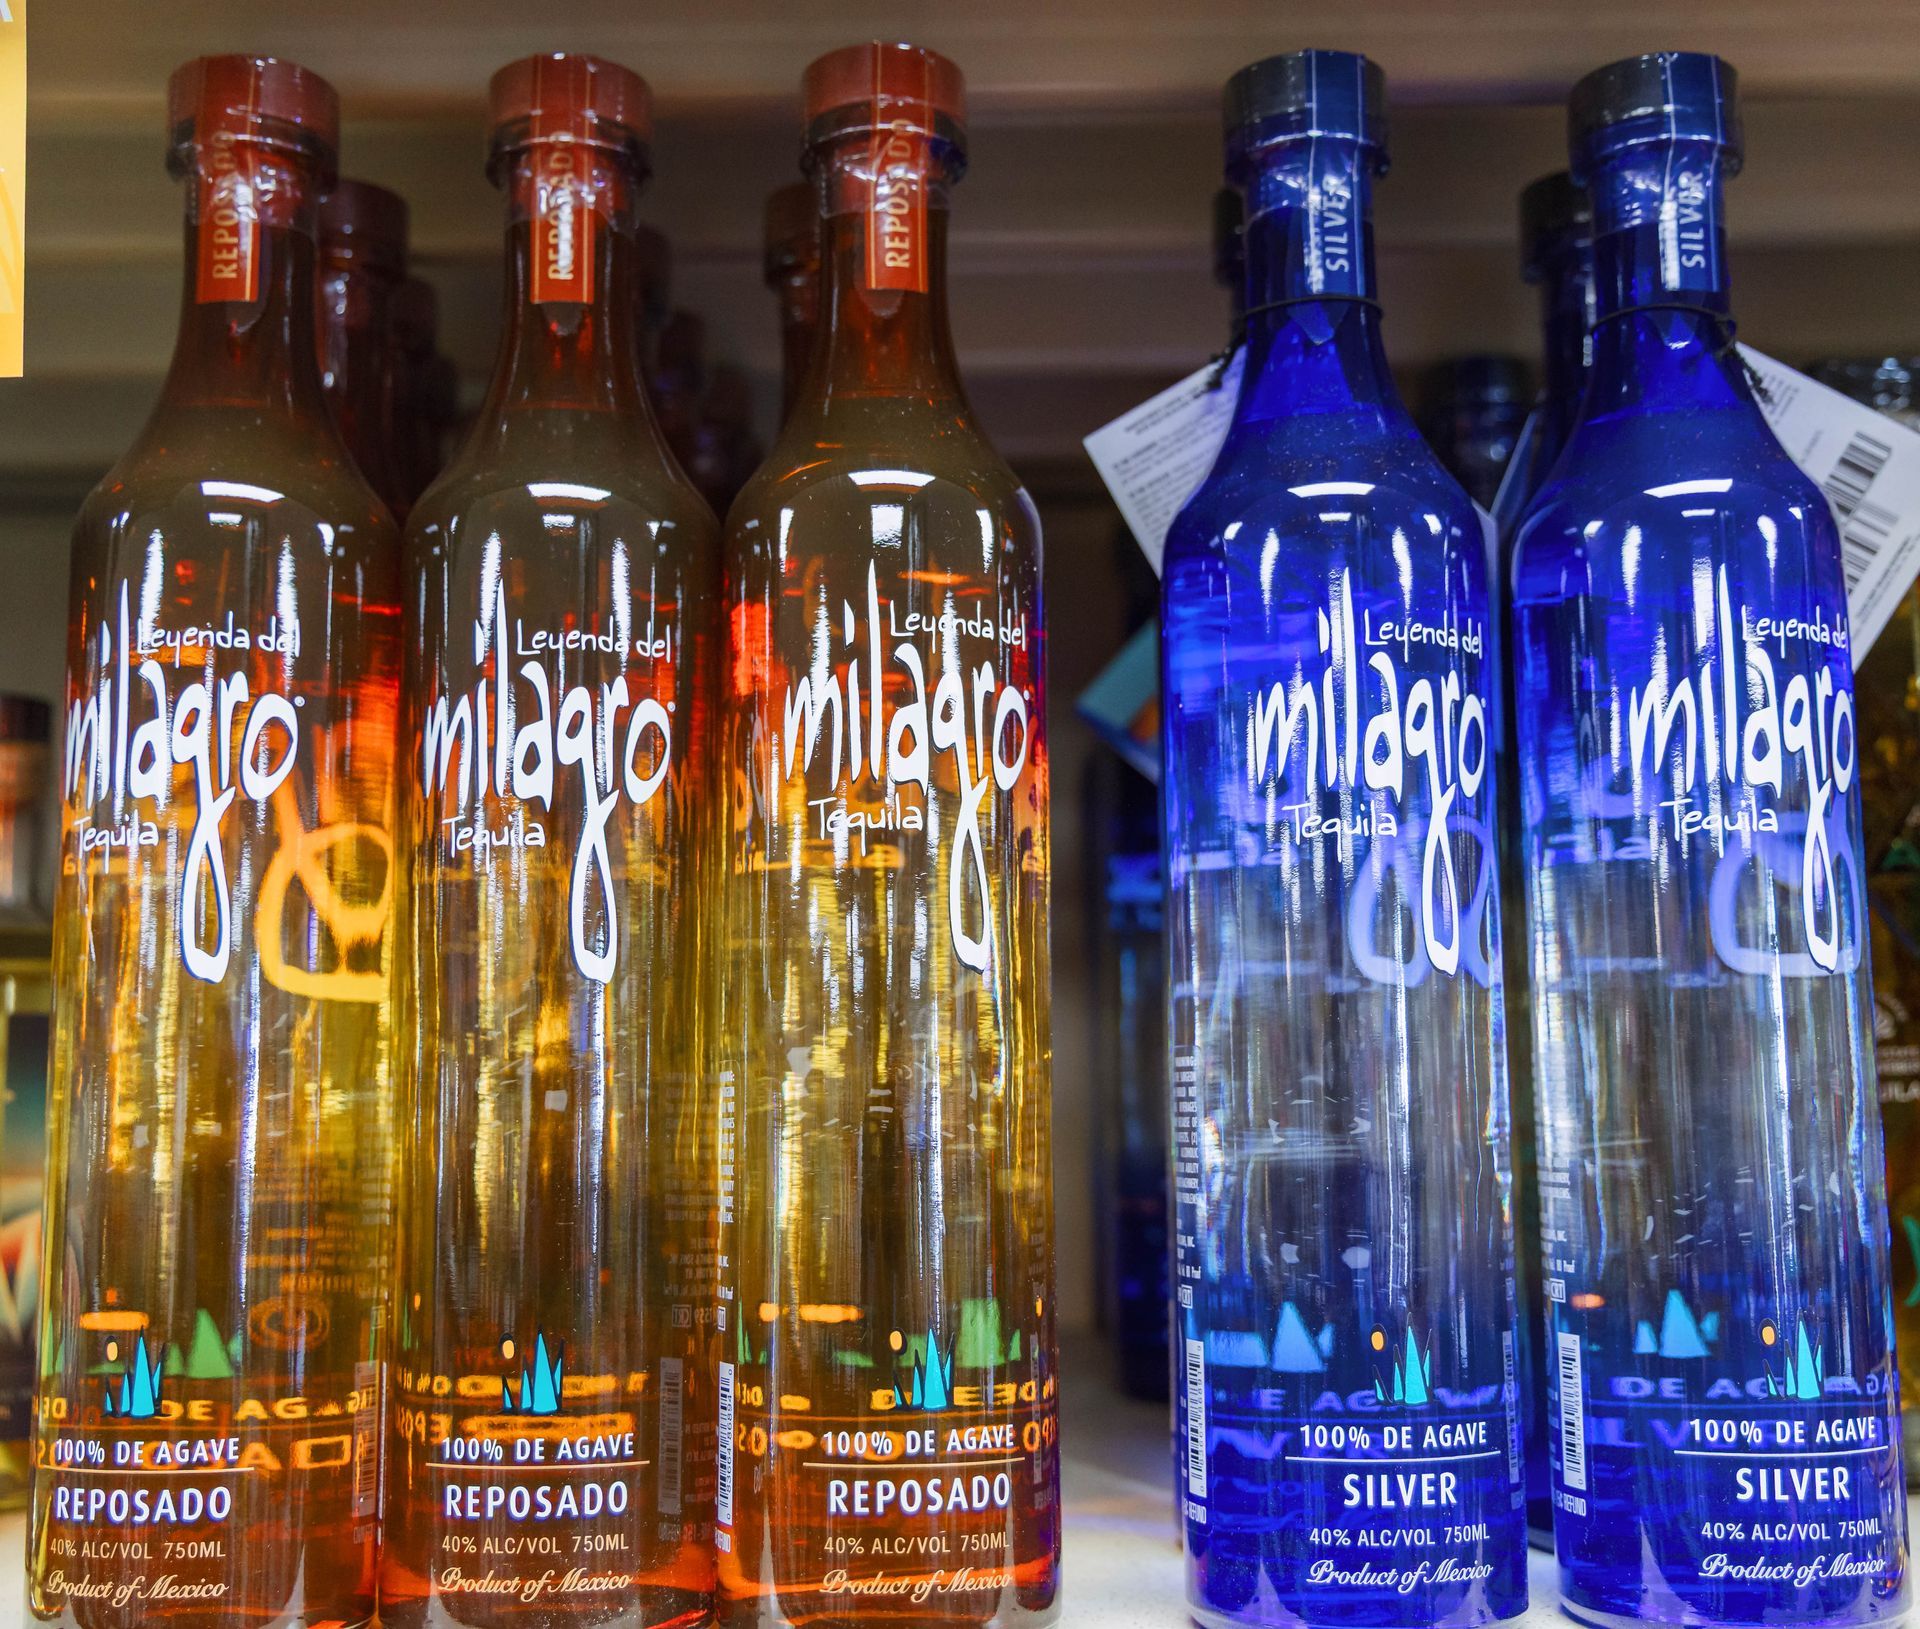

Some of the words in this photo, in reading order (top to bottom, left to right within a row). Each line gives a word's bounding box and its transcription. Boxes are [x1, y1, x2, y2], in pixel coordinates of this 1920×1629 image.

[1323, 175, 1351, 272] SILVER
[137, 610, 250, 668] Leyenda
[516, 615, 629, 670] Leyenda
[636, 621, 670, 663] del
[1000, 608, 1026, 652] del
[1364, 609, 1459, 662] Leyenda
[1462, 619, 1482, 658] del
[1742, 603, 1830, 657] Leyenda
[74, 811, 159, 874] Tequila
[442, 811, 545, 871] Tequila
[808, 796, 923, 855] Tequila
[1282, 804, 1398, 862] Tequila
[1659, 794, 1778, 858] Tequila
[442, 1437, 503, 1462] 100%
[517, 1437, 545, 1462] DE
[558, 1434, 634, 1459] AGAVE
[823, 1431, 893, 1455] 100%
[906, 1430, 935, 1454] DE
[947, 1424, 1014, 1451] AGAVE
[1300, 1424, 1369, 1450] 100%
[1384, 1425, 1412, 1449] DE
[1423, 1421, 1486, 1448] AGAVE
[1689, 1419, 1762, 1443] 100%
[1776, 1420, 1805, 1444] DE
[1816, 1416, 1875, 1443] AGAVE
[56, 1439, 104, 1464] 100%
[118, 1440, 144, 1464] DE
[157, 1437, 239, 1462] AGAVE
[829, 1473, 1010, 1514] REPOSADO
[1343, 1472, 1457, 1506] SILVER
[1736, 1466, 1850, 1500] SILVER
[56, 1486, 231, 1522] REPOSADO
[447, 1483, 628, 1520] REPOSADO
[50, 1538, 78, 1559] 40%
[82, 1539, 152, 1559] ALC/VOL
[164, 1537, 225, 1558] 750ML
[442, 1536, 476, 1555] 40%
[482, 1535, 562, 1555] ALC/VOL
[572, 1532, 629, 1552] 750ML
[824, 1535, 864, 1555] 40%
[872, 1534, 950, 1555] ALC/VOL
[961, 1530, 1010, 1552] 750ML
[1309, 1528, 1350, 1546] 40%
[1358, 1528, 1435, 1547] ALC/VOL
[1444, 1525, 1490, 1543] 750ML
[1701, 1522, 1744, 1541] 40%
[1751, 1522, 1830, 1542] ALC/VOL
[1839, 1520, 1882, 1538] 750ML
[437, 1566, 514, 1598] Product
[518, 1567, 549, 1602] of
[551, 1565, 633, 1592] Mexico
[820, 1567, 906, 1595] Product
[911, 1570, 943, 1602] of
[944, 1567, 1012, 1592] Mexico
[1306, 1559, 1398, 1587] Product
[1400, 1561, 1428, 1592] of
[1432, 1558, 1492, 1581] Mexico
[1698, 1553, 1790, 1579] Product
[1794, 1555, 1824, 1587] of
[1825, 1553, 1885, 1577] Mexico
[46, 1570, 114, 1598] Product
[112, 1575, 133, 1607] of
[135, 1575, 229, 1599] Mexico
